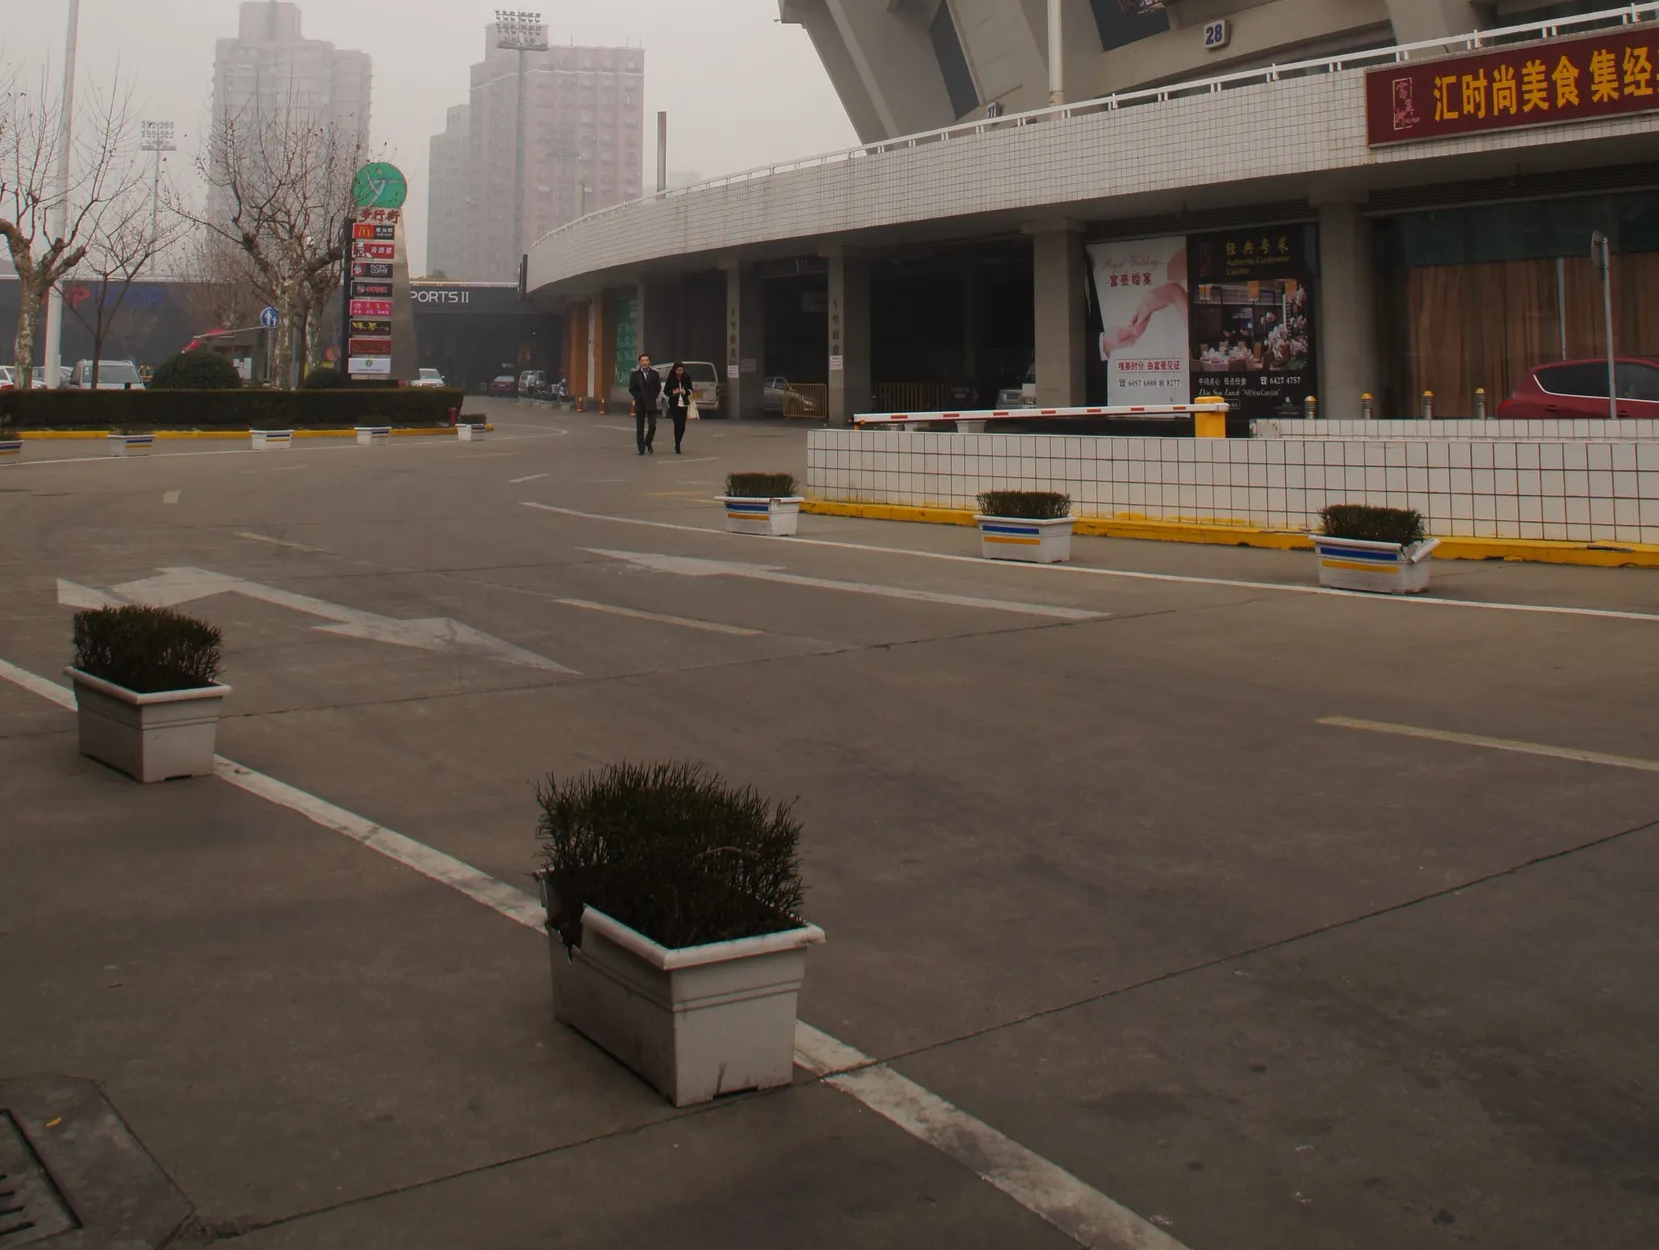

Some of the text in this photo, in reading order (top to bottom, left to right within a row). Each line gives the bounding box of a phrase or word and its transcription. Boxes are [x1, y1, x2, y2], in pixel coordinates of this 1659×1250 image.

[1205, 23, 1223, 45] 28
[1433, 55, 1580, 122] 汇时尚美食
[1589, 46, 1659, 103] 集经
[358, 207, 400, 223] 步行街
